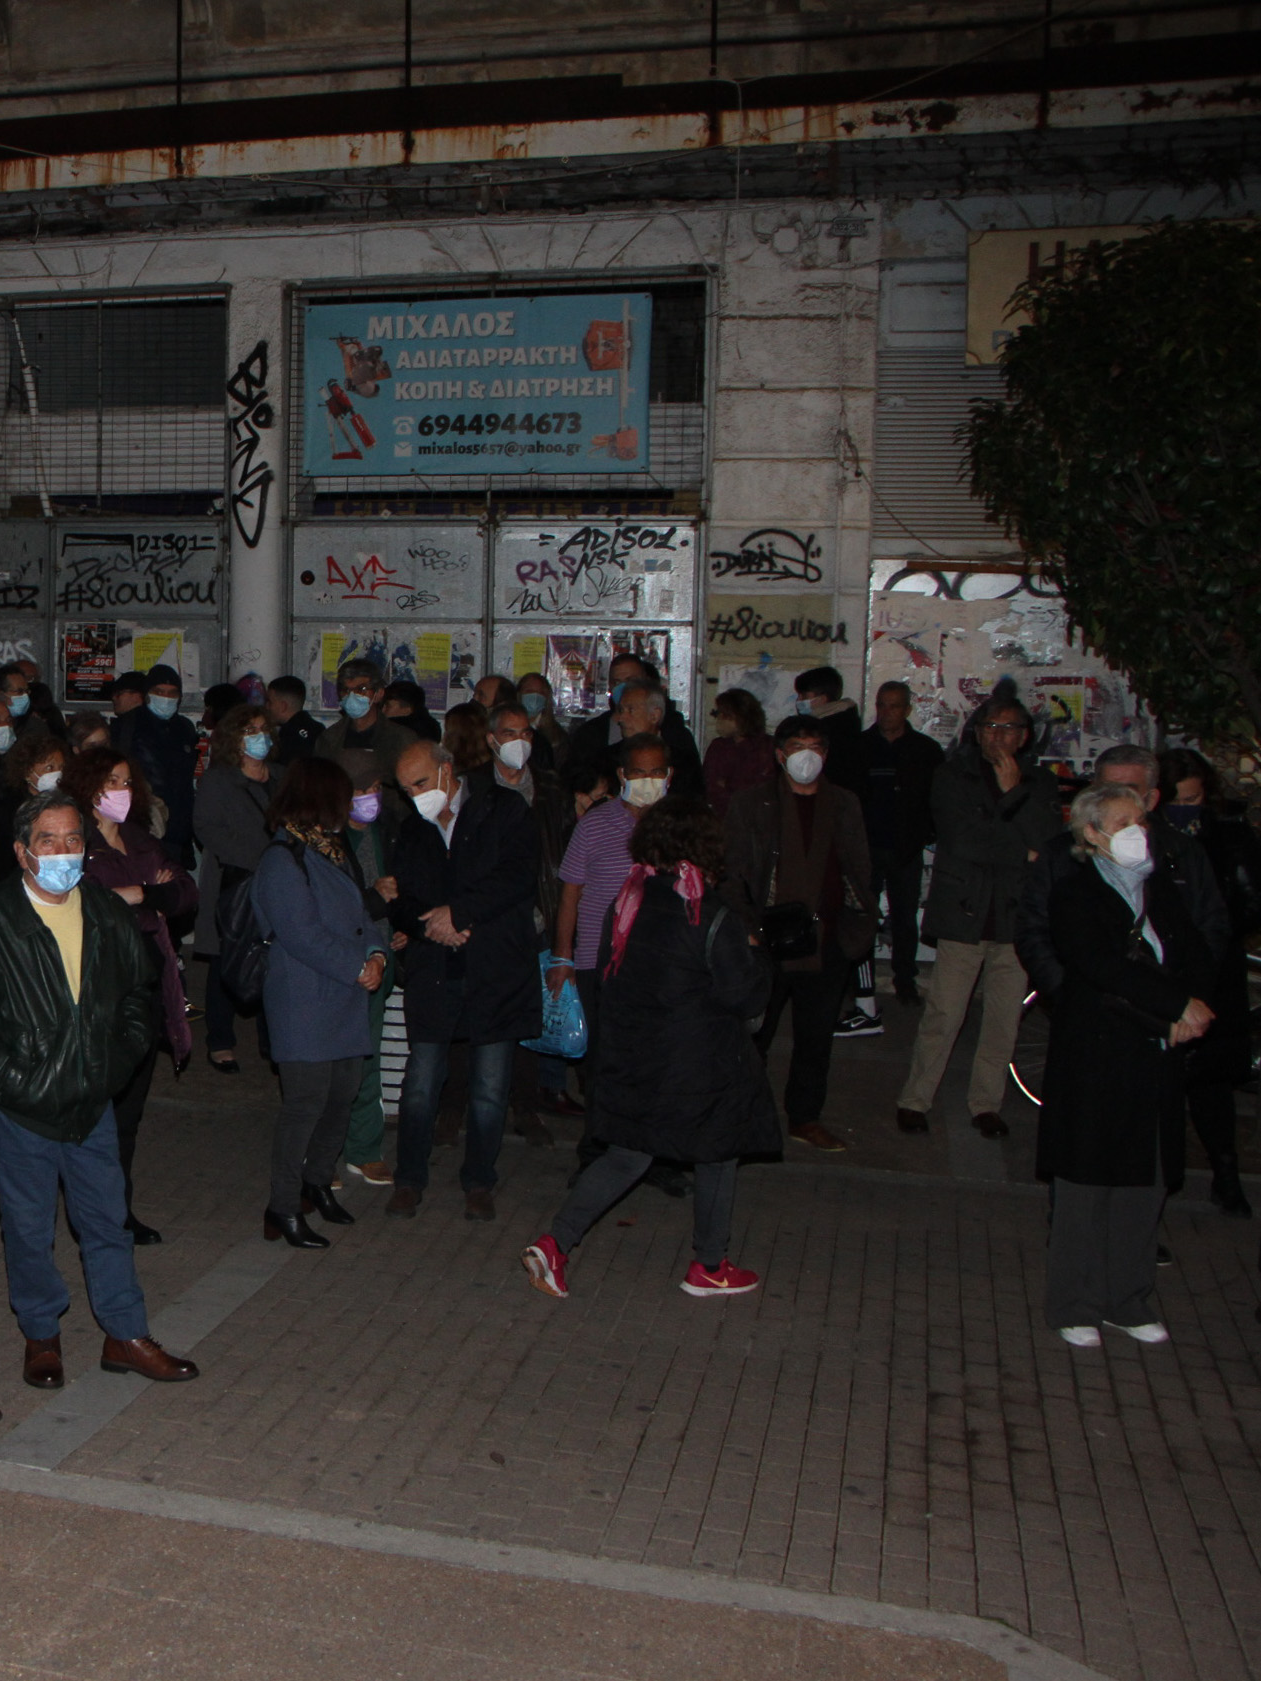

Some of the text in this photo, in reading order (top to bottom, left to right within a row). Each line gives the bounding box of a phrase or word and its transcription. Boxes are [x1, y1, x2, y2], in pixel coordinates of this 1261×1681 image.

[367, 311, 515, 340] ΜΙΧΑΛΟΣ
[396, 345, 577, 370] ΑΔΙΑΤΑΡΡΑΚΤΗ
[395, 376, 615, 401] ΚΟΠΗ & ΔΙΑΤΡΗΣΗ
[418, 412, 583, 436] 6944944673
